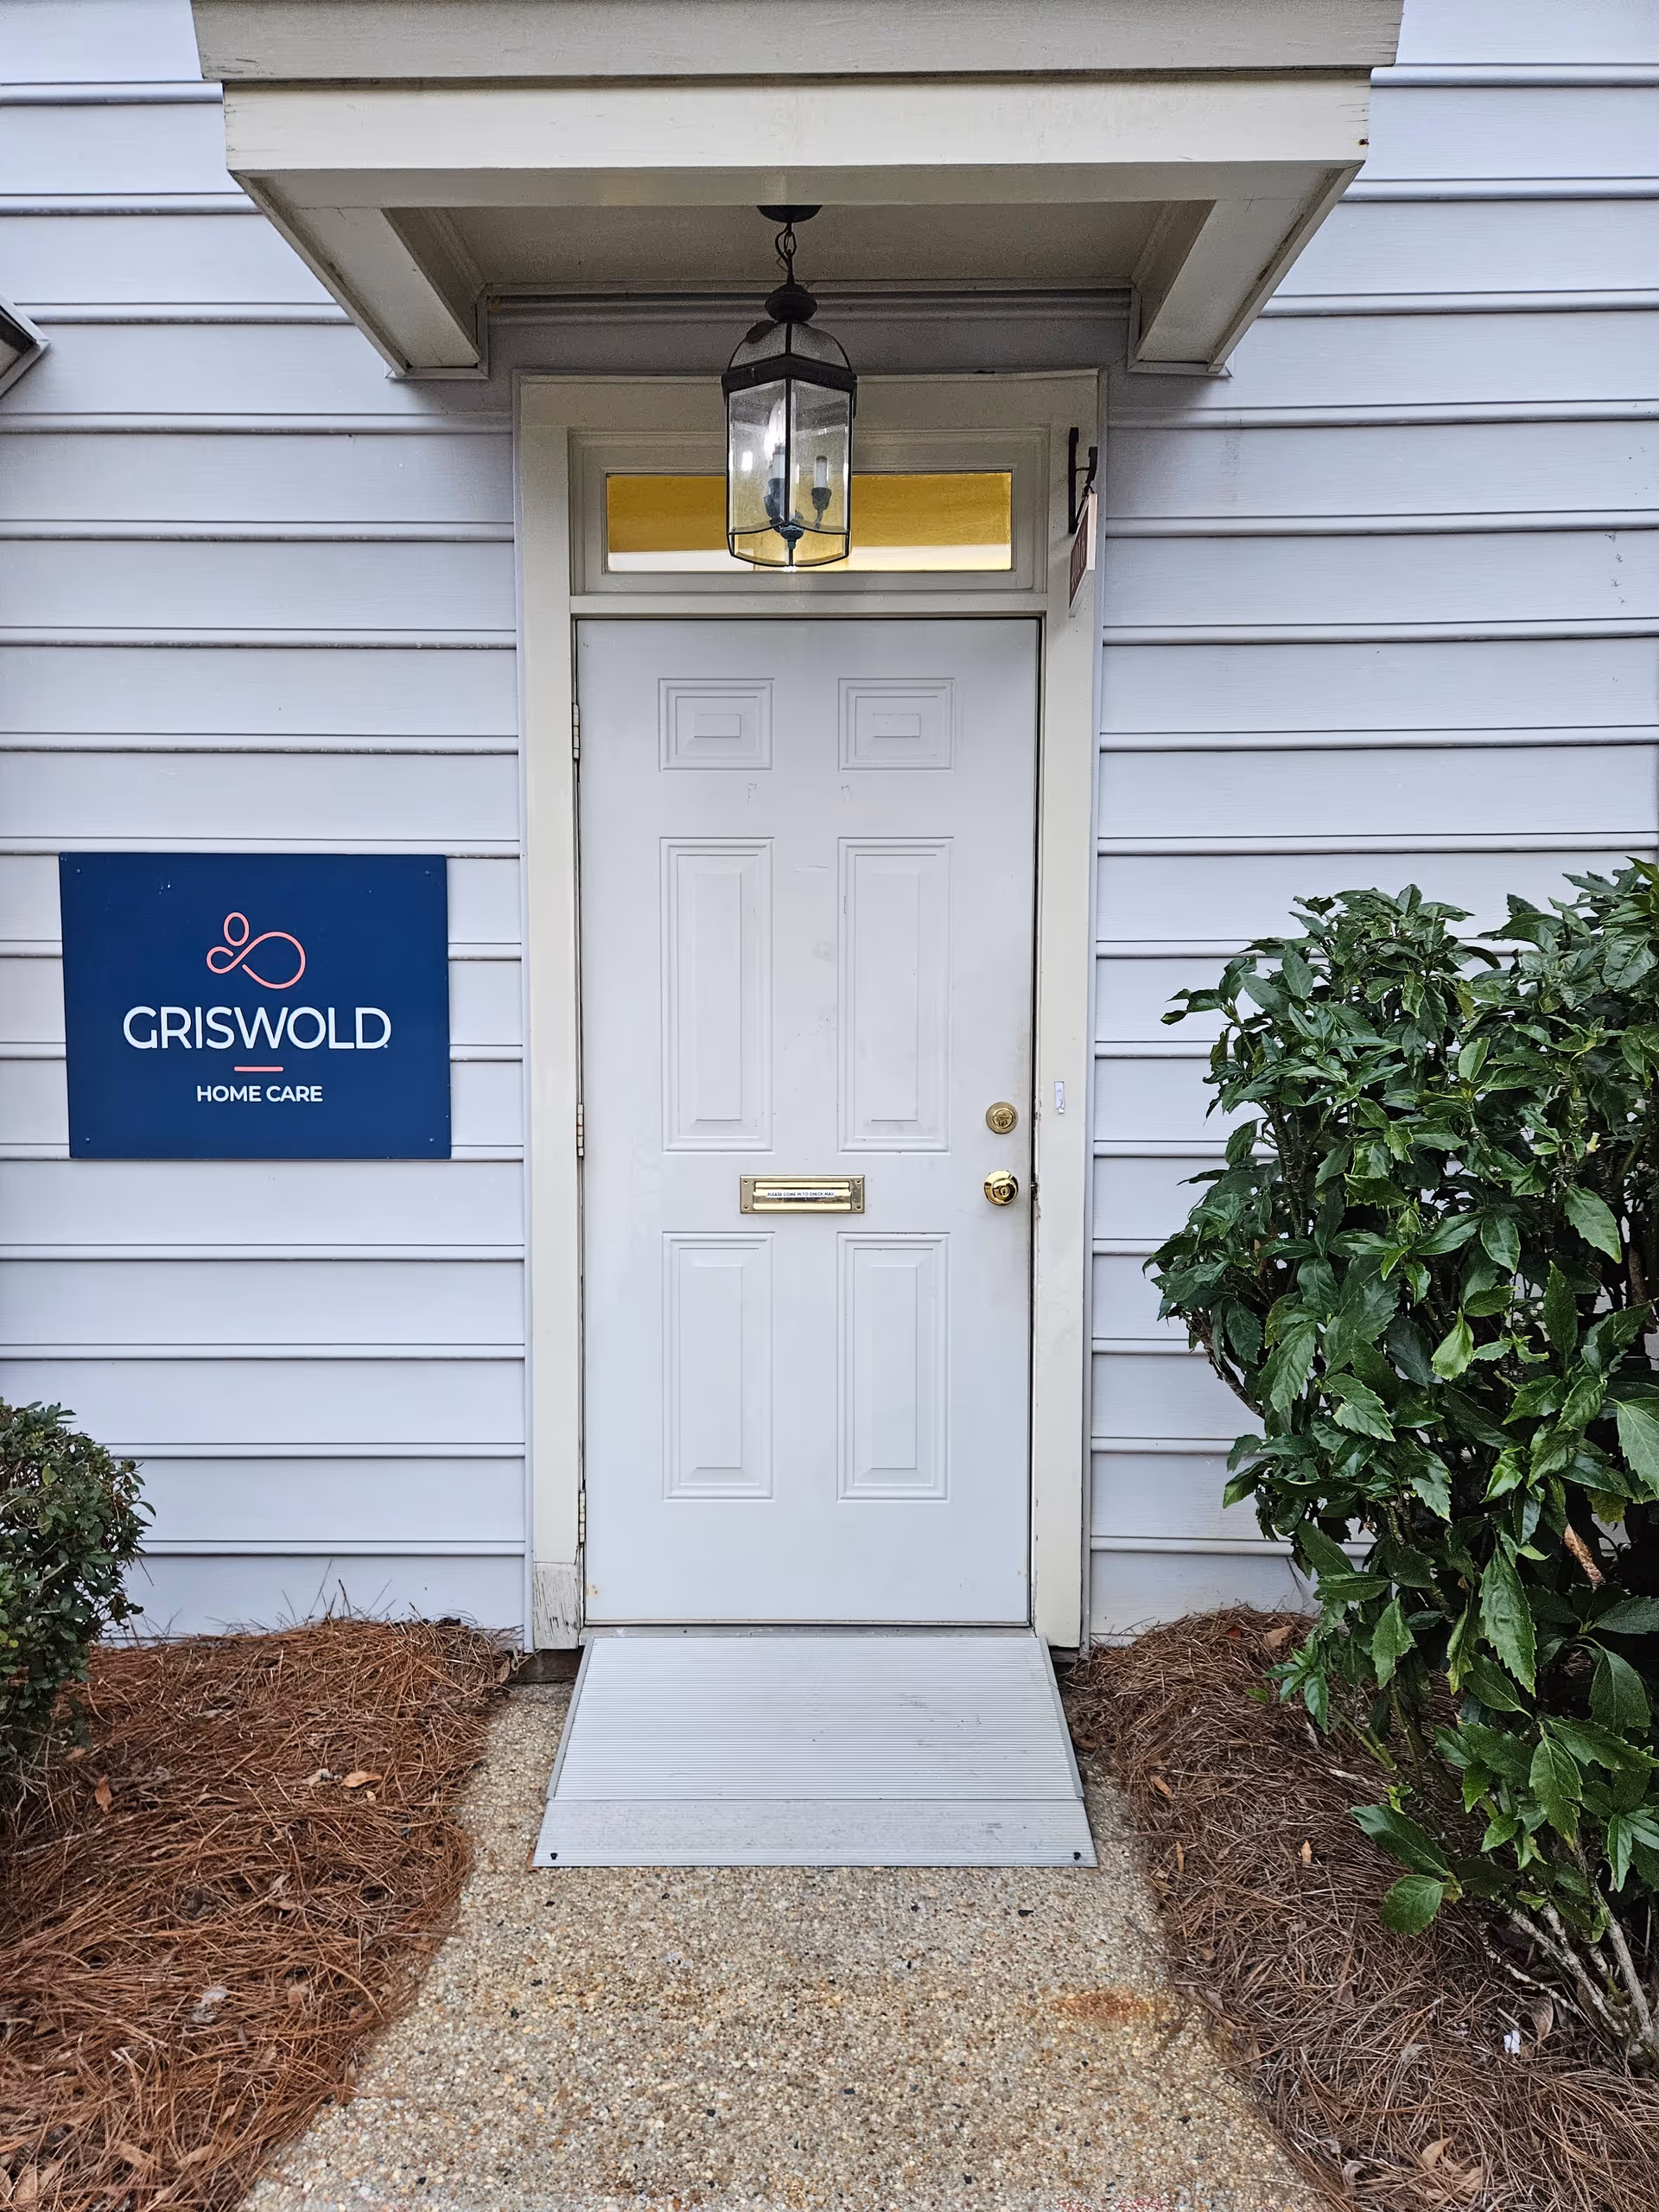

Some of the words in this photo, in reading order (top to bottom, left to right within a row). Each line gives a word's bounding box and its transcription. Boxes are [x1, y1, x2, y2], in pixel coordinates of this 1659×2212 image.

[122, 1006, 392, 1050] GRISWOLD
[196, 1084, 262, 1103] HOME
[266, 1084, 324, 1103] CARE
